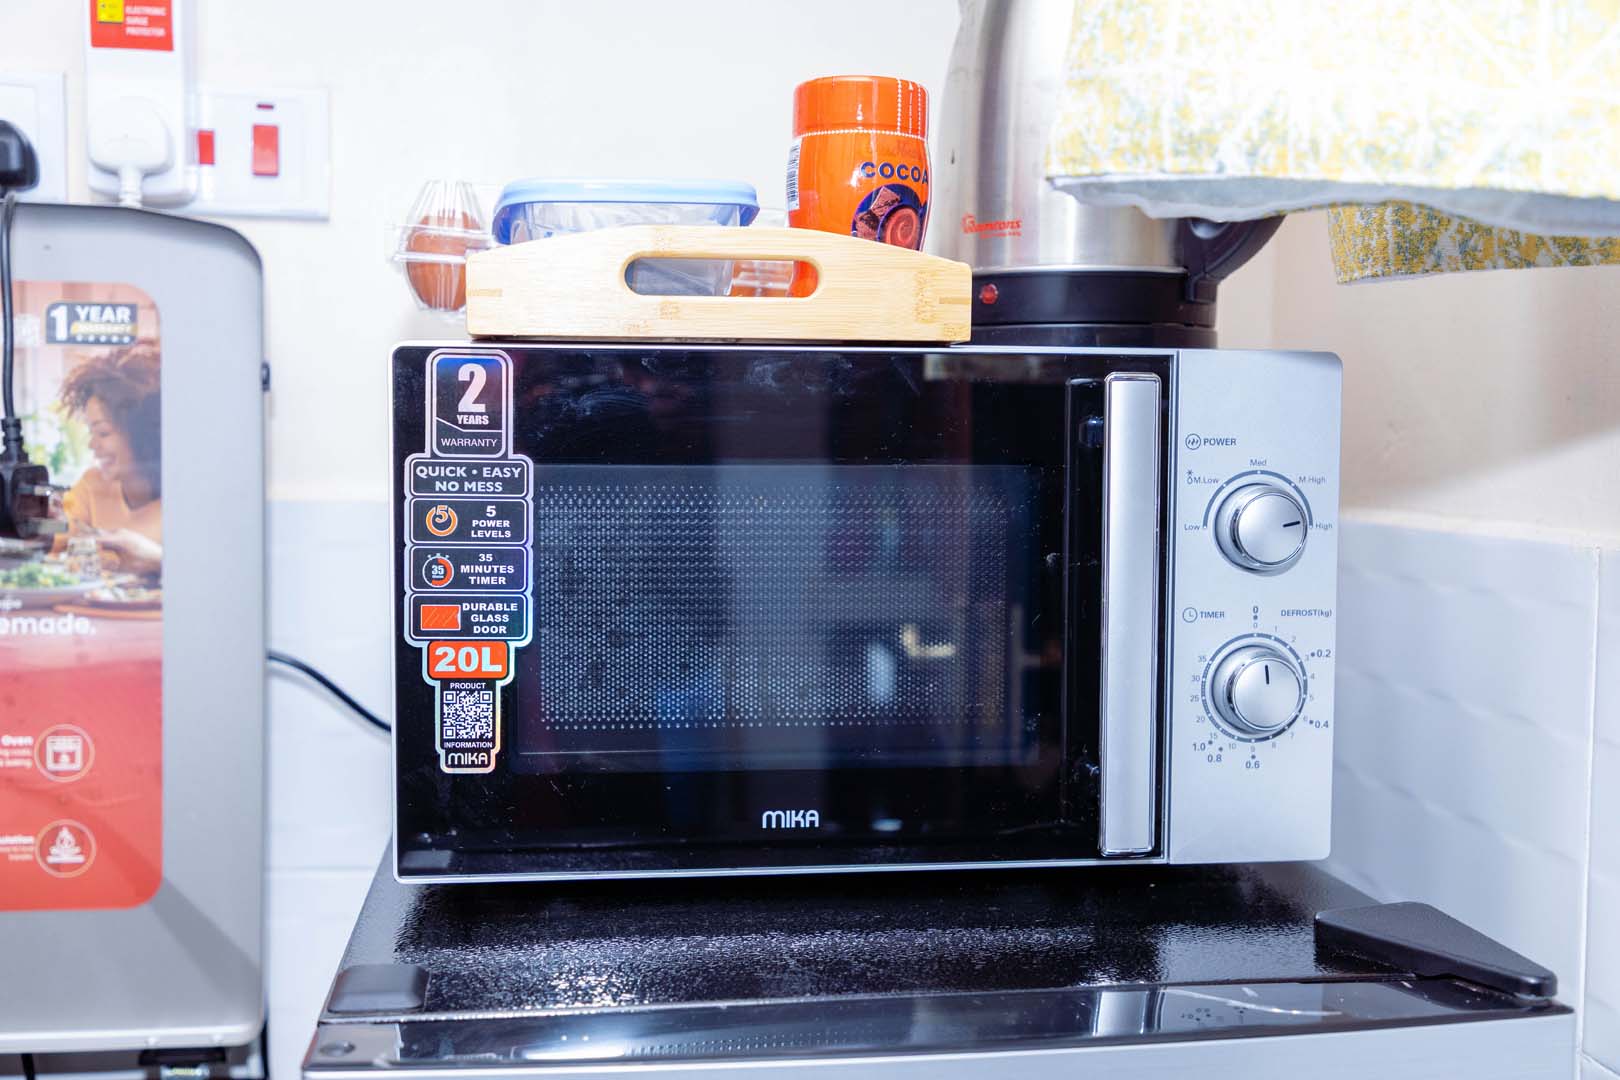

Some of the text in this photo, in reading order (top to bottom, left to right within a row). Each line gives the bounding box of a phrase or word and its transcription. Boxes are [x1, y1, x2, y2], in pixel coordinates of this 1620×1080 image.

[860, 161, 928, 184] COCOA
[51, 304, 67, 341] 1
[75, 305, 131, 323] YEAR
[458, 363, 487, 413] 2
[457, 415, 489, 425] YEARS
[441, 438, 498, 447] WARRANTY
[1203, 438, 1237, 446] POWER
[416, 466, 522, 478] QUICK EASY
[435, 481, 503, 492] NO MESS
[486, 505, 496, 517] 5
[472, 519, 510, 528] POWER
[1184, 523, 1200, 531] Low
[1315, 522, 1333, 531] High
[471, 530, 511, 538] LEVELS
[478, 553, 493, 562] 35
[431, 565, 445, 575] 35
[460, 565, 514, 574] MINUTES
[468, 576, 506, 585] TIMER
[462, 603, 518, 611] DURABLE
[1252, 606, 1259, 614] 0
[470, 614, 509, 622] GLASS
[1200, 611, 1225, 619] TIMER
[473, 625, 507, 634] DOOR
[1316, 649, 1331, 658] 0.2
[434, 646, 502, 672] 20L
[1314, 720, 1329, 728] 0.4
[1192, 743, 1206, 751] 1.0
[448, 752, 488, 765] MIKA
[1207, 754, 1222, 763] 0.8
[1245, 761, 1260, 769] 0.6
[762, 809, 819, 829] MIKA
